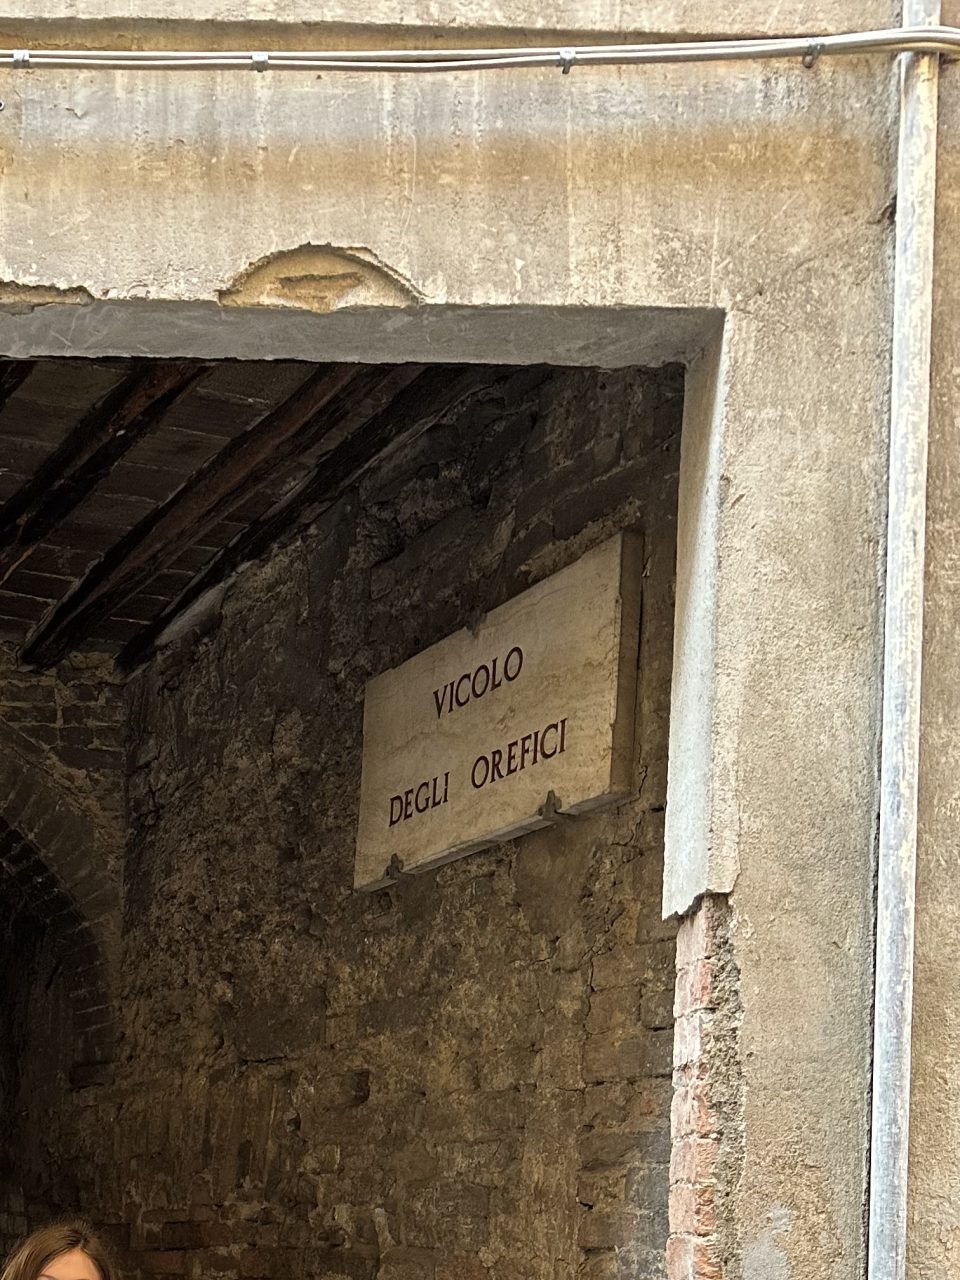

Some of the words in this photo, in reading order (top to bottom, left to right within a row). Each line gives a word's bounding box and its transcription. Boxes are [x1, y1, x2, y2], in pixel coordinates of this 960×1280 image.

[432, 646, 524, 719] VICOLO
[388, 771, 450, 828] DEGLI
[470, 717, 568, 789] OREFICI
